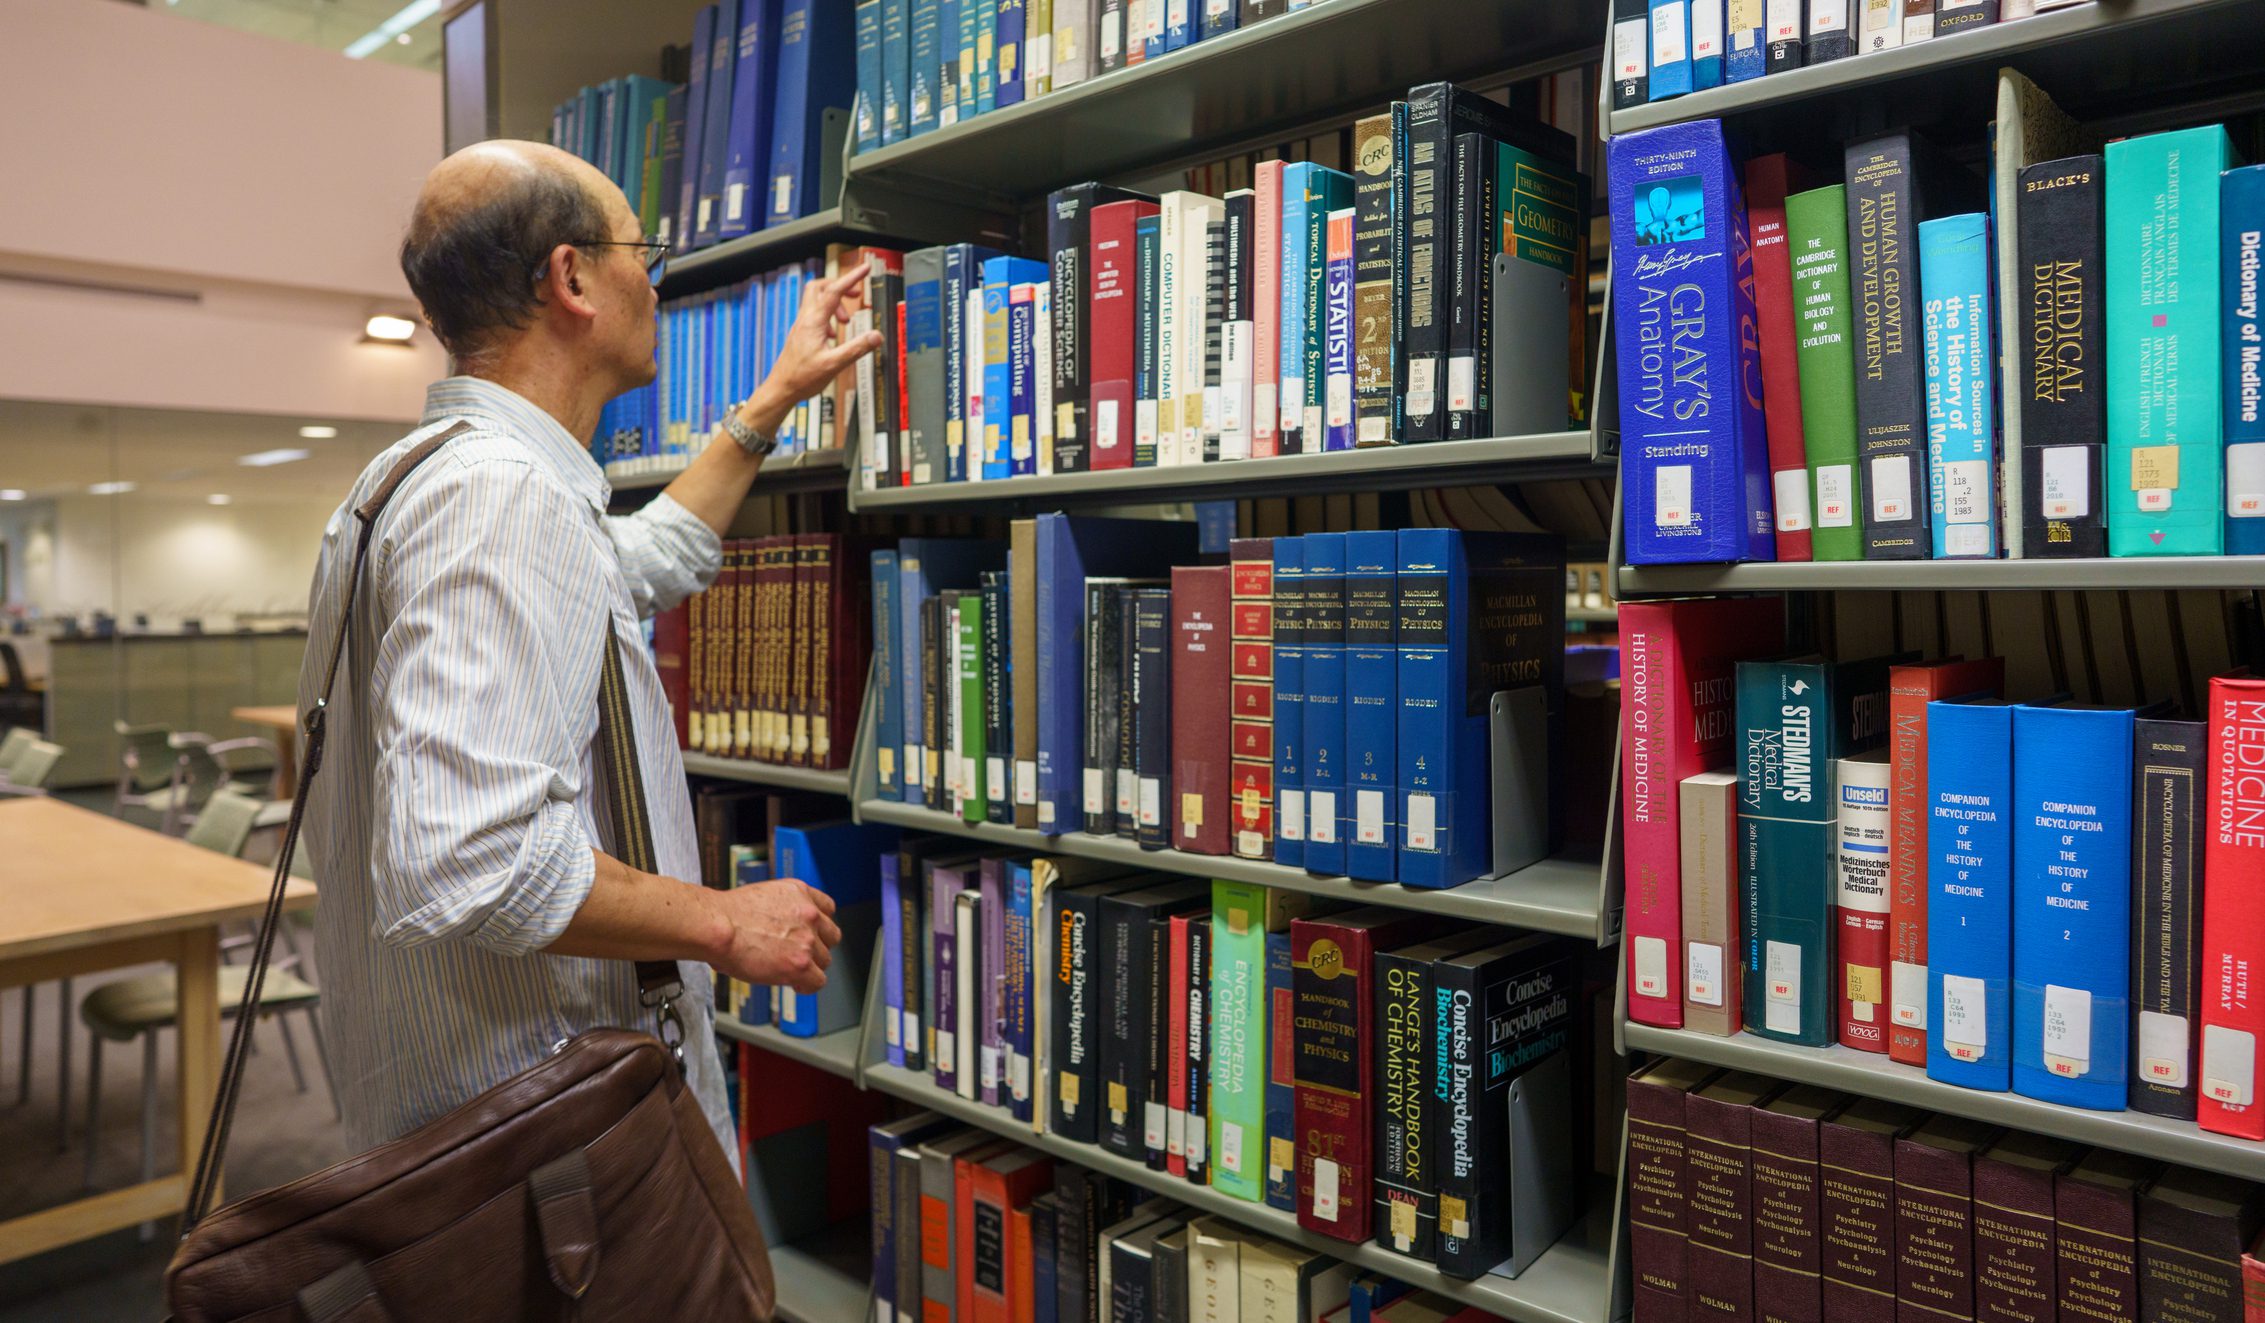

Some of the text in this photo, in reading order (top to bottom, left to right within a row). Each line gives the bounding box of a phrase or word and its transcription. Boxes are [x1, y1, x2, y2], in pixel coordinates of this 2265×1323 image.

[1941, 12, 1984, 28] OXFORD
[1412, 100, 1438, 111] SPANIER
[1412, 110, 1438, 120] OLDHAM
[1363, 145, 1389, 164] CRC
[1634, 149, 1697, 166] THIRTY-NINTH
[1870, 155, 1884, 163] THE
[1648, 161, 1683, 174] EDITION
[1858, 159, 1898, 173] CAMBRIDGE
[1855, 167, 1901, 183] ENCYCLOPEDIA
[1873, 179, 1882, 187] OF
[2027, 173, 2090, 192] BLACK'S
[1458, 183, 1464, 195] ON
[1517, 204, 1575, 241] GEOMETRY
[1758, 222, 1780, 232] HUMAN
[1412, 142, 1434, 327] AN ATLAS OF FUNCTIONS
[1756, 234, 1784, 246] ANATOMY
[1808, 239, 1821, 248] THE
[1358, 259, 1391, 270] STATISTICS
[1796, 248, 1835, 265] CAMBRIDGE
[1797, 262, 1838, 280] DICTIONARY
[1880, 192, 1902, 355] HUMAN GROWTH
[1813, 280, 1821, 289] OF
[1860, 197, 1882, 379] AND DEVELOPMENT
[1310, 267, 1321, 332] DICTIONARY
[1806, 292, 1831, 305] HUMAN
[1056, 250, 1064, 389] COMPUTER SCIENCE
[1064, 248, 1075, 379] ENCYCLOPEDIA OF
[1804, 305, 1834, 320] BIOLOGY
[1162, 253, 1172, 400] COMPUTER DICTIONAR
[1813, 322, 1827, 331] AND
[2034, 263, 2054, 402] DICTIONARY
[2056, 259, 2083, 402] MEDICAL
[2236, 231, 2260, 422] Dictionary of Medicine
[1803, 333, 1841, 347] EVOLUTION
[1012, 306, 1024, 397] Computing
[1634, 284, 1668, 419] Anatomy
[1669, 283, 1709, 421] GRAY'S
[1946, 297, 1967, 430] the History of
[1308, 349, 1320, 405] STATISTIC
[1969, 294, 1982, 452] Information Sources in
[1926, 300, 1945, 512] Science and Medicine
[1868, 424, 1910, 435] ULIJASZEK
[1645, 443, 1709, 458] Standring
[1868, 437, 1910, 449] JOHNSTON
[1953, 478, 1966, 486] 118
[1827, 505, 1839, 514] REF
[1954, 507, 1972, 515] 1983
[1872, 538, 1913, 548] CAMBRIDGE
[1405, 590, 1438, 599] MACMILLAN
[1401, 599, 1443, 609] ENCYCLOPEDIA
[1401, 616, 1442, 631] PHYSICS
[1406, 697, 1438, 708] RIGDEN
[1633, 634, 1648, 823] HISTORY OF MEDICINE
[1782, 705, 1811, 803] STEDMAN'S
[2152, 744, 2186, 752] ROSNER
[1416, 756, 1425, 769] 4
[1765, 728, 1781, 789] Medical
[1744, 728, 1760, 809] Dictionary
[2220, 700, 2235, 844] IN QUOTATIONS
[2236, 700, 2264, 847] MEDICINE
[1845, 788, 1884, 802] Unseld
[1941, 793, 1990, 805] COMPANION
[1896, 713, 1920, 906] MEDICAL MEANINGS
[1935, 807, 1996, 822] ENCYCLOPEDIA
[2043, 802, 2096, 815] COMPANION
[1958, 825, 1969, 835] OF
[2035, 816, 2102, 832] ENCYCLOPEDIA
[1956, 840, 1972, 850] THE
[2062, 835, 2074, 845] OF
[1840, 855, 1890, 869] Medizinisches
[1946, 854, 1982, 867] HISTORY
[2059, 851, 2076, 862] THE
[1958, 871, 1969, 880] OF
[2048, 865, 2088, 879] HISTORY
[1848, 875, 1877, 886] Medical
[2061, 883, 2073, 892] OF
[1845, 883, 1883, 896] Dictionary
[1945, 883, 1984, 897] MEDICINE
[2046, 896, 2089, 910] MEDICINE
[1961, 916, 1966, 926] 1
[2064, 930, 2070, 940] 2
[1059, 909, 1072, 984] Chemistry
[1312, 949, 1338, 968] CRC
[1070, 912, 1086, 1064] Concise Encyclopedia
[1506, 973, 1552, 1005] Concise
[2222, 954, 2231, 1011] MURRAY
[2236, 960, 2246, 1009] HUTH /
[1190, 935, 1202, 1062] DICTIONARY OF CHEMISTRY
[1301, 993, 1349, 1008] HANDBOOK
[1232, 960, 1247, 1095] ENCYCLOPEDIA
[1295, 1016, 1357, 1037] CHEMISTRY
[1491, 996, 1566, 1045] Encyclopedia
[1218, 969, 1232, 1092] of CHEMISTRY
[1387, 969, 1403, 1120] OF CHEMISTRY
[1435, 987, 1451, 1101] Biochemistry
[1304, 1043, 1349, 1062] PHYSICS
[1491, 1031, 1566, 1078] Biochemistry
[1957, 1048, 1971, 1057] REF
[1406, 971, 1420, 1180] LANGE'S HANDBOOK
[2056, 1064, 2071, 1073] REF
[1453, 990, 1471, 1177] Concise Encyclopedia
[1824, 1179, 1887, 1200] INTERNATIONAL
[1826, 1190, 1885, 1209] ENCYCLOPEDIA
[1836, 1214, 1876, 1230] Psychiatry
[1835, 1226, 1877, 1243] Psychology
[1828, 1235, 1886, 1256] Psychoanalysis
[1838, 1260, 1876, 1276] Neurology
[1642, 1274, 1676, 1290] WOLMAN
[1700, 1295, 1735, 1312] WOLMAN
